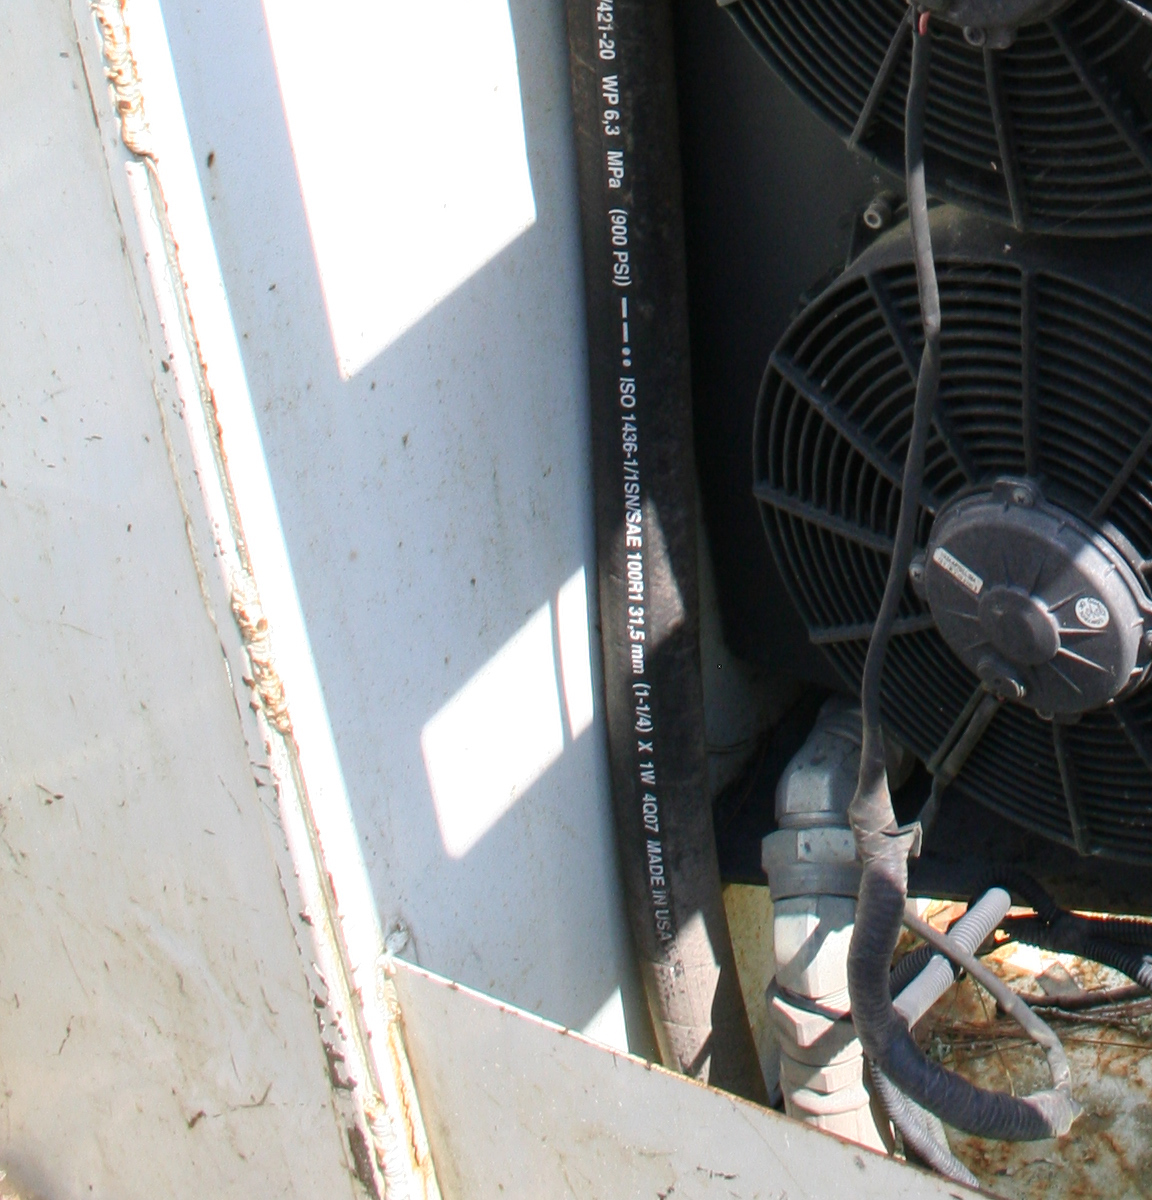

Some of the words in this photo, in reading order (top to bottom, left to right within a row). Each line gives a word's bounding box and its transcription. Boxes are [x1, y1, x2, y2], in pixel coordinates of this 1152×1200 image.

[601, 75, 619, 105] WP
[602, 109, 621, 136] 6,3
[606, 150, 624, 189] MPa
[608, 208, 629, 246] (900
[612, 250, 632, 287] PSI)
[619, 376, 636, 408] ISO
[621, 413, 642, 548] 1436-1/1SN/SAE
[626, 552, 644, 601] 100R1
[626, 606, 647, 641] 31,5
[631, 644, 646, 675] mm
[632, 682, 654, 733] (1-1/4)
[637, 740, 653, 753] X
[639, 761, 656, 786] 1W
[641, 792, 660, 833] 4Q07
[646, 839, 666, 887] MADE
[652, 889, 669, 907] IN
[654, 908, 673, 942] USA
